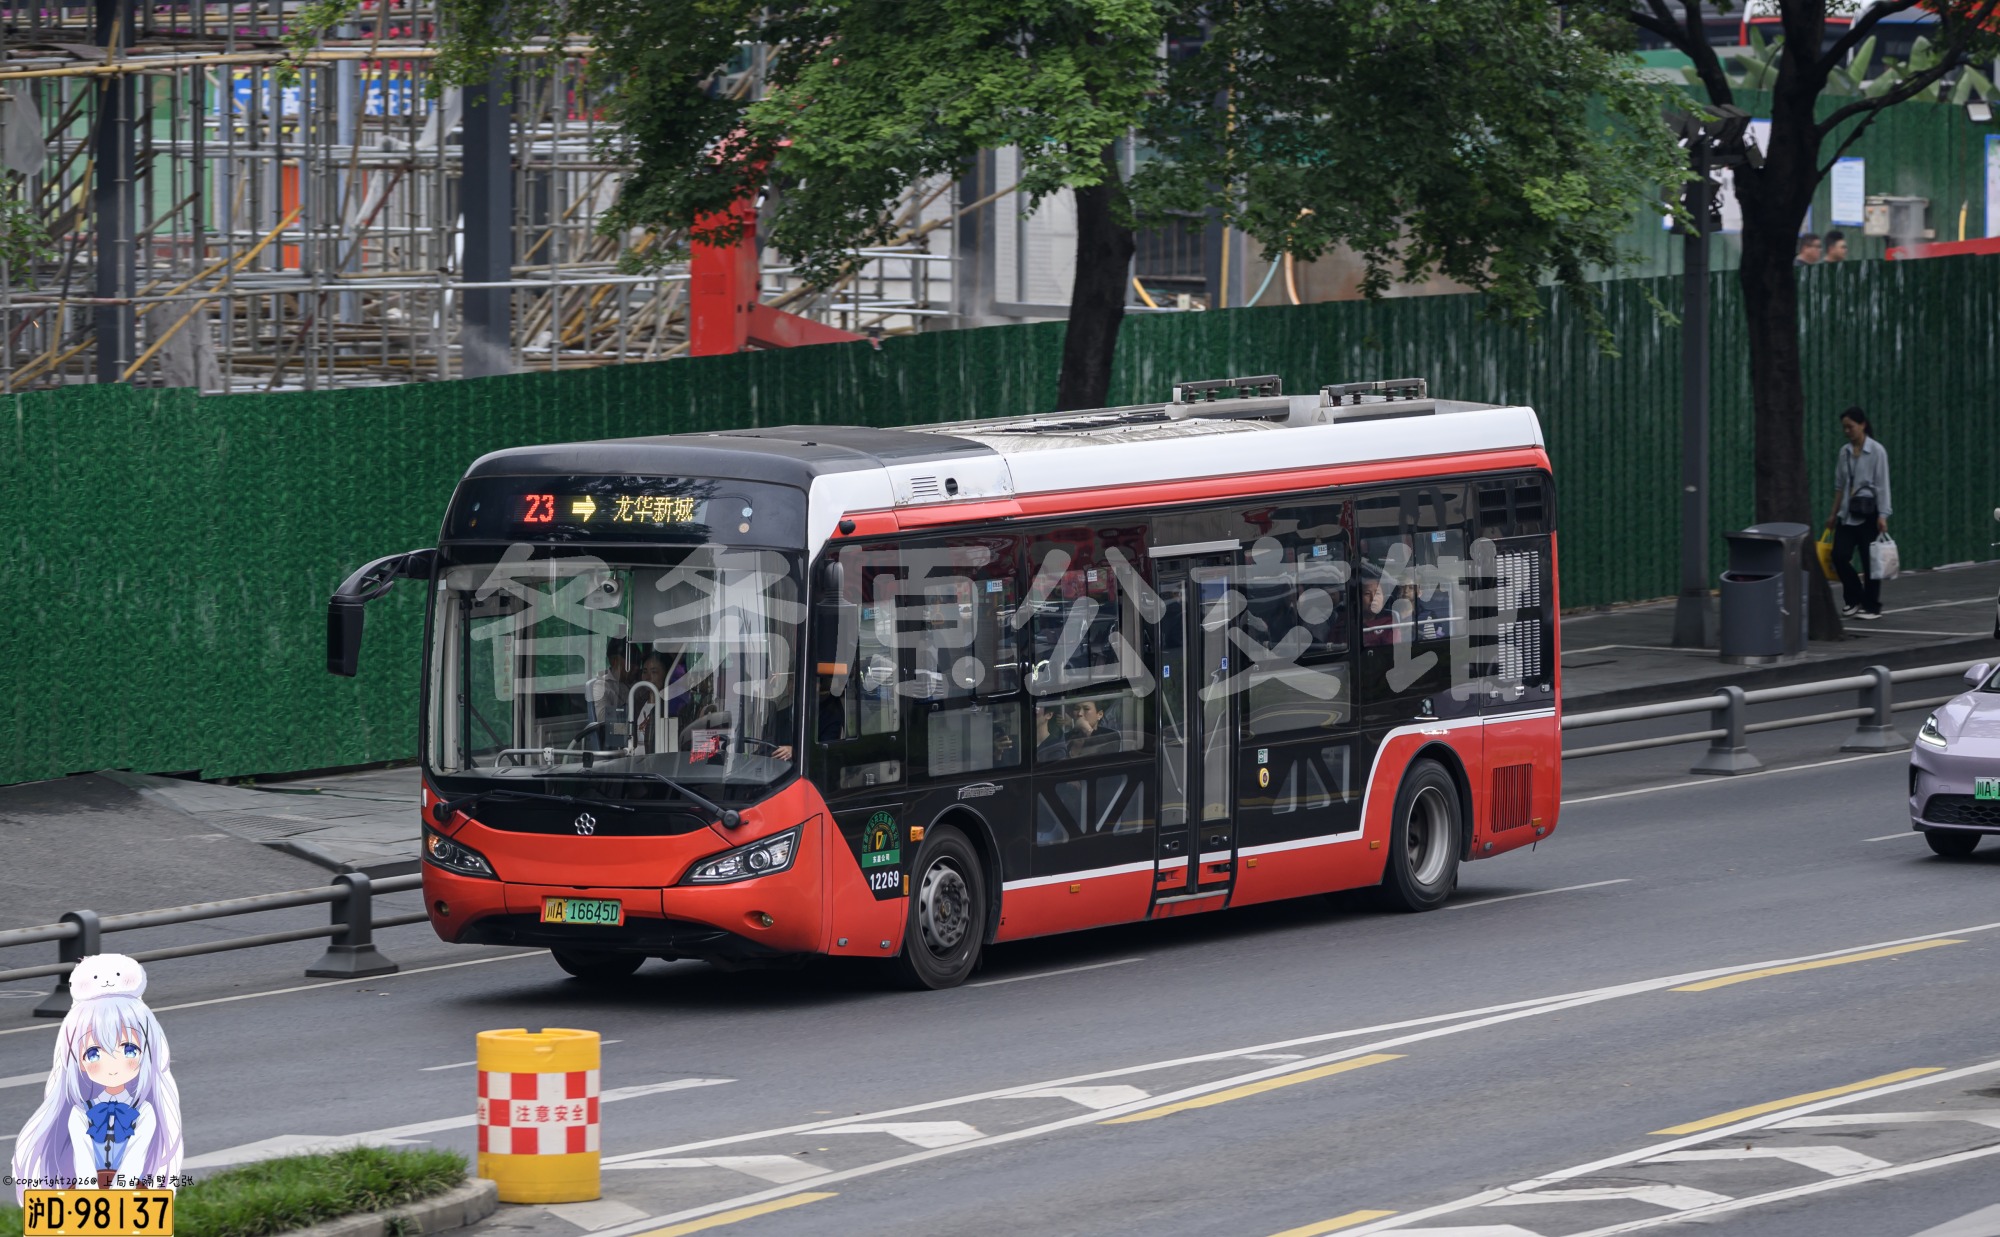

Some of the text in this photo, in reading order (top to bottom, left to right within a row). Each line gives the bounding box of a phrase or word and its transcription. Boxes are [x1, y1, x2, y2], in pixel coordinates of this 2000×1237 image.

[523, 494, 694, 523] 23 龙华新城
[870, 870, 900, 891] 12269
[516, 1104, 584, 1122] 注意安全
